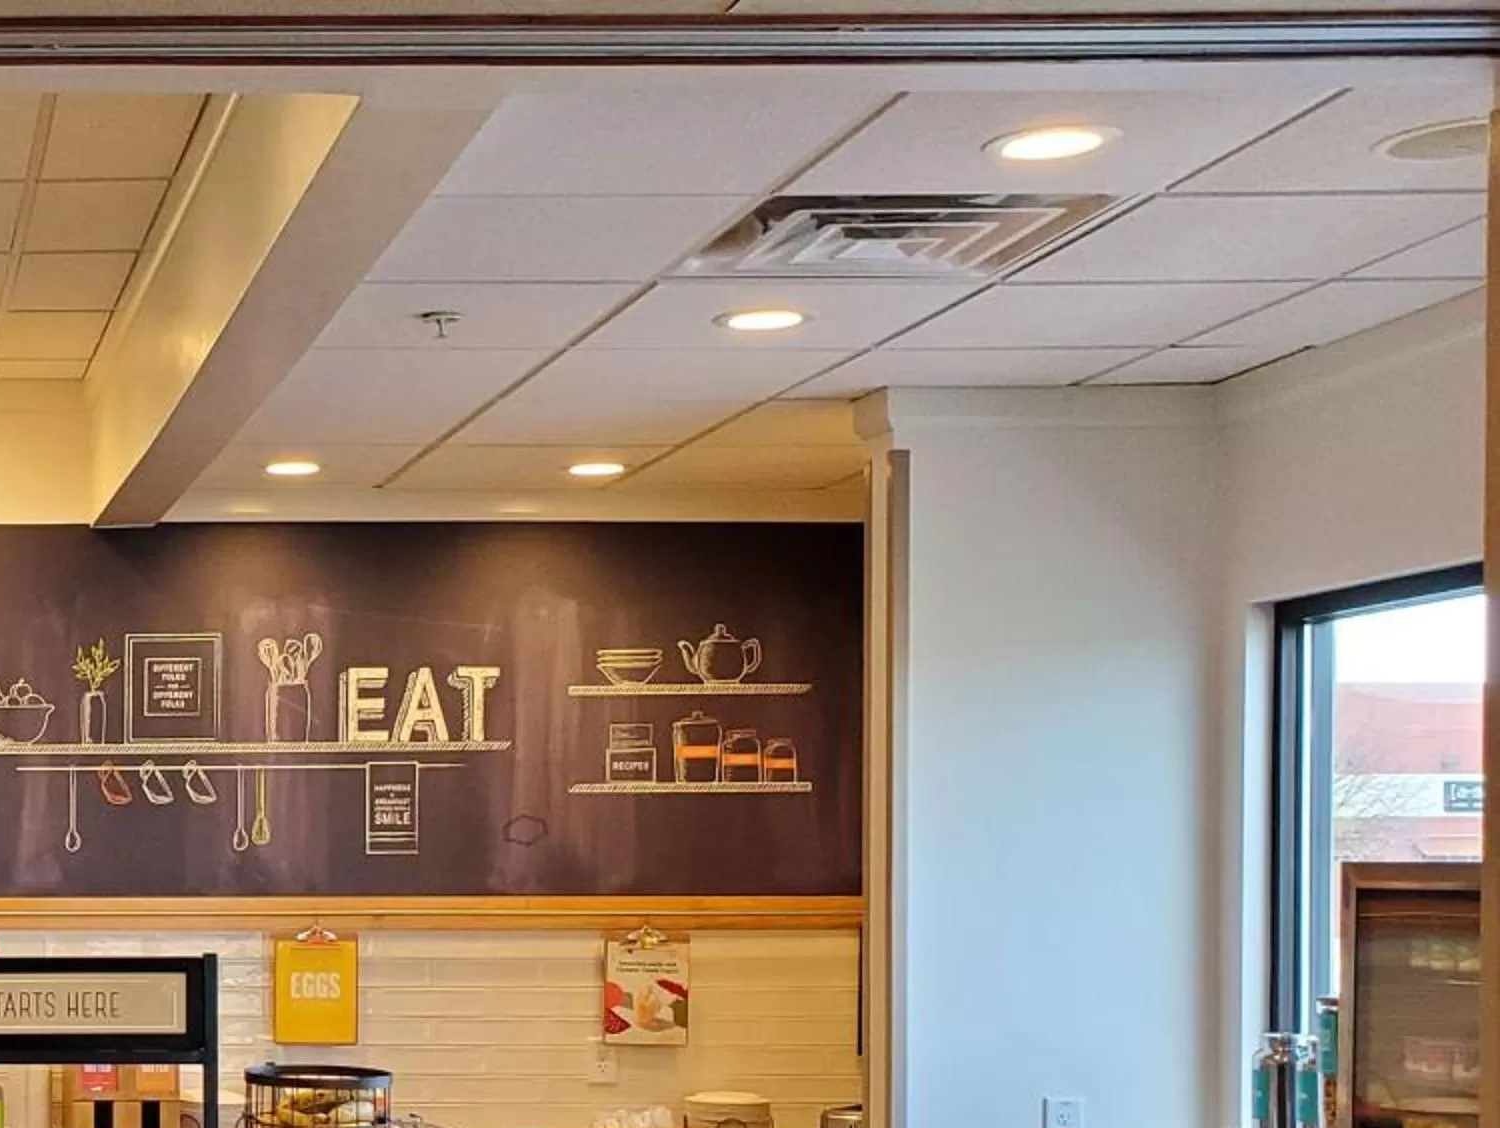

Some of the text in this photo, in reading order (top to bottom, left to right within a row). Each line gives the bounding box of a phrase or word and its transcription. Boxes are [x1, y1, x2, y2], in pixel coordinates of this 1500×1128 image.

[339, 666, 500, 742] EAT
[375, 812, 412, 825] SMILE
[291, 971, 341, 999] EGGS
[67, 991, 121, 1019] HERE
